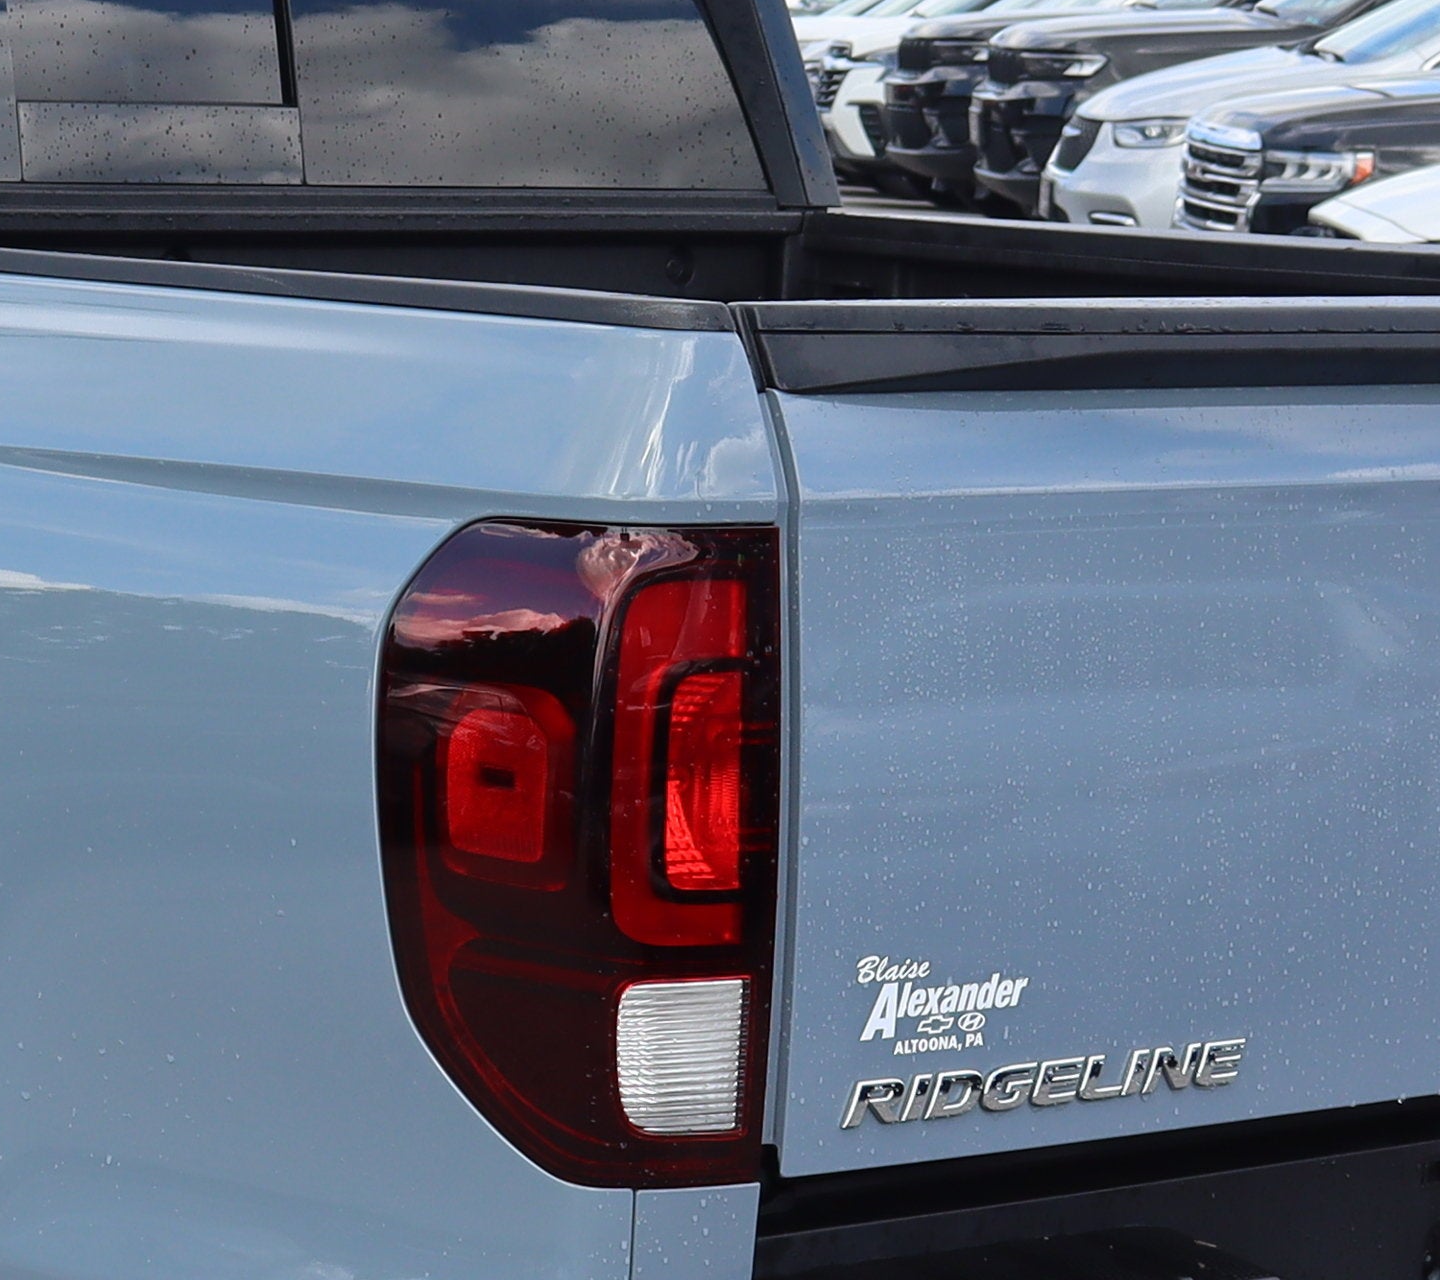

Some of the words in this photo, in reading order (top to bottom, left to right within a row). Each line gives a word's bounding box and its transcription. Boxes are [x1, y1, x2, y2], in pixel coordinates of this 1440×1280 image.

[857, 955, 931, 984] Blaise
[860, 972, 1030, 1042] Alexander
[893, 1035, 962, 1056] ALTOONA,
[965, 1032, 984, 1048] PA
[840, 1037, 1247, 1130] RIDGELINE
